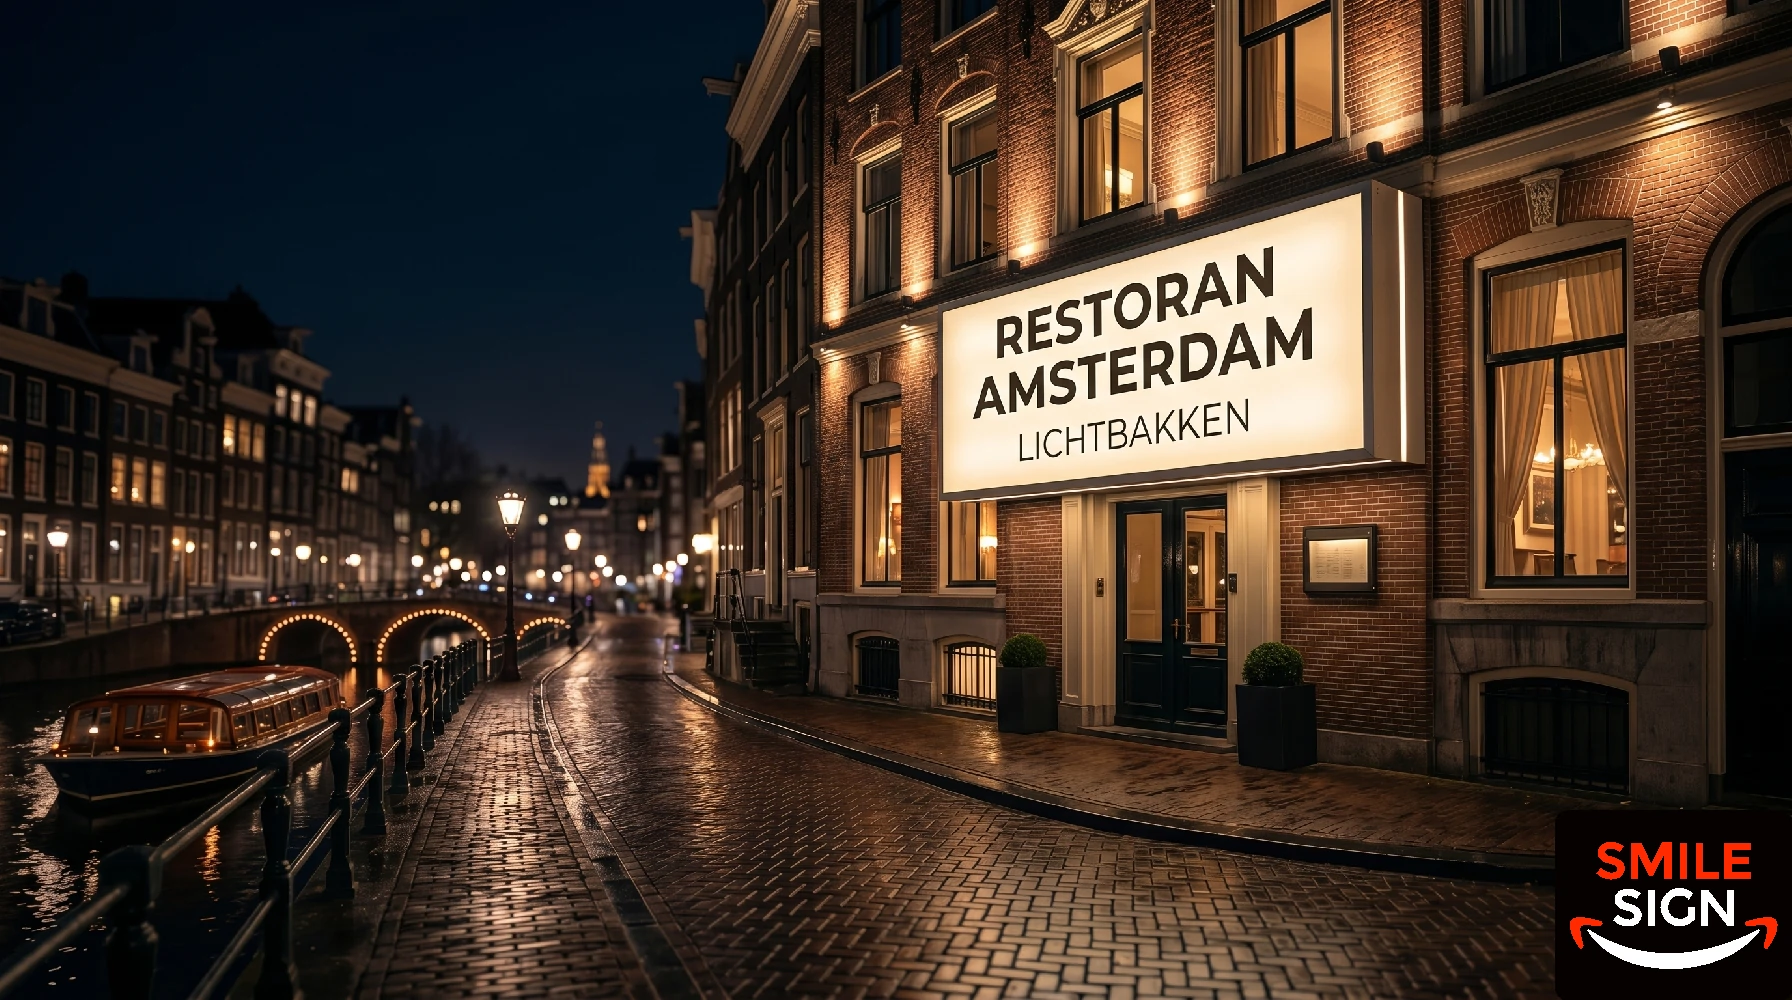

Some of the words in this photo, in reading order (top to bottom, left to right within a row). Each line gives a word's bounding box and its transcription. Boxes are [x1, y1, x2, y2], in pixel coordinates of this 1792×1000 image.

[996, 246, 1274, 359] RESTORAN
[973, 307, 1313, 420] AMSTERDAM
[1019, 399, 1250, 462] LICHTBAKKEN
